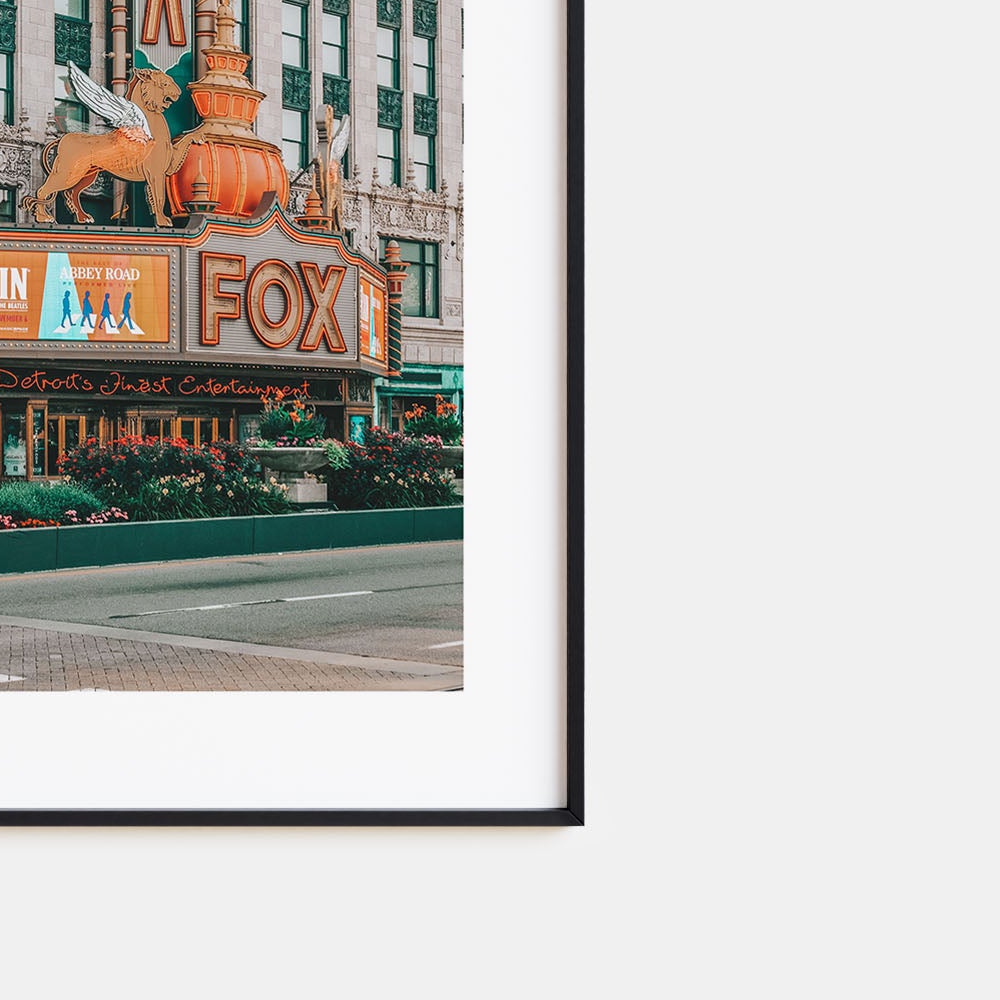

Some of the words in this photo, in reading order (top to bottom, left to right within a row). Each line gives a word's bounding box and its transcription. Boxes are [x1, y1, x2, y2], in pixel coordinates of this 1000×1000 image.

[60, 266, 103, 280] ABBEY
[105, 267, 140, 281] ROAD
[199, 251, 348, 353] FOX
[178, 375, 311, 399] Entertainment
